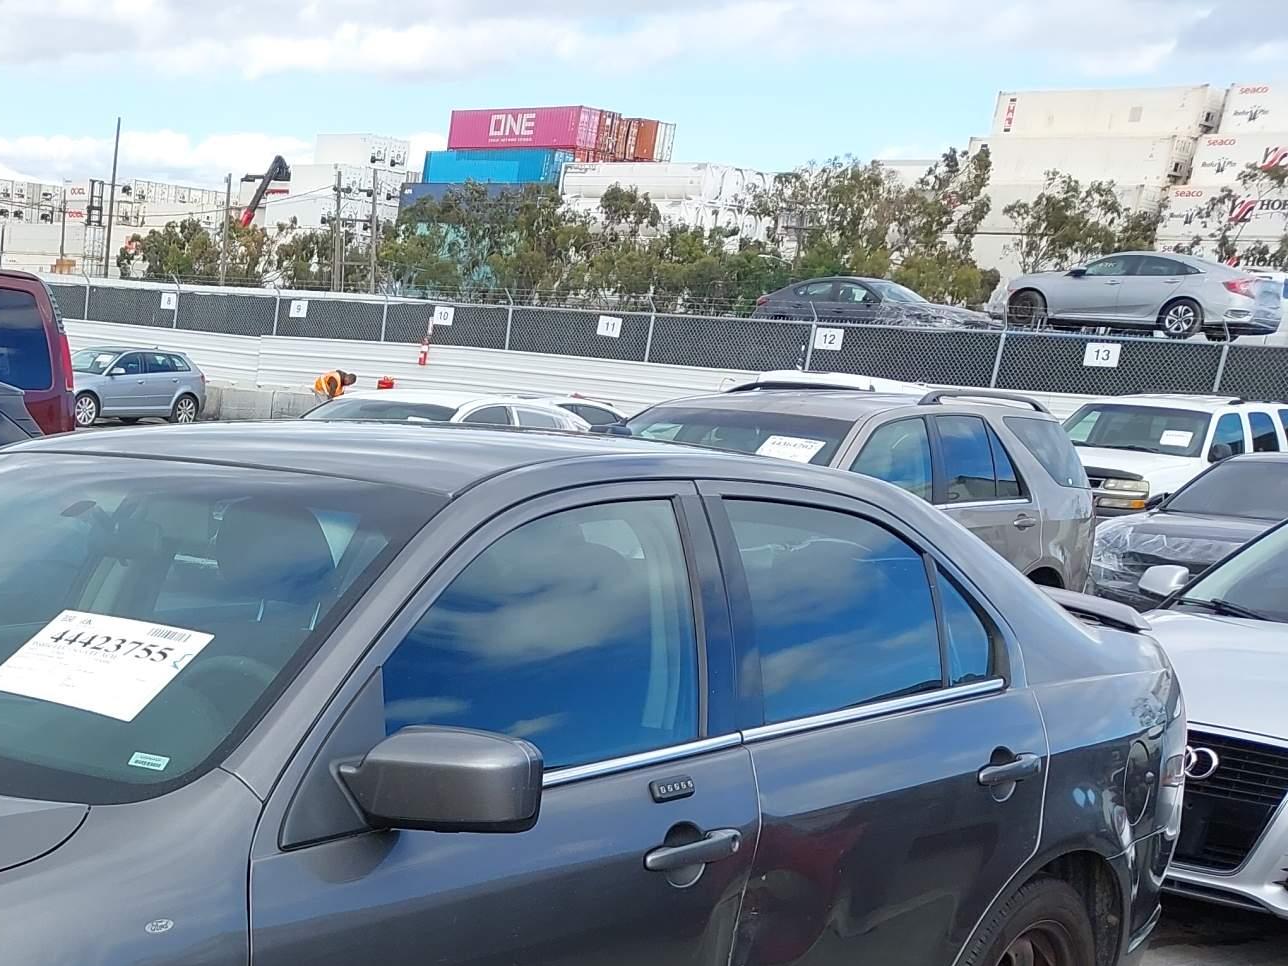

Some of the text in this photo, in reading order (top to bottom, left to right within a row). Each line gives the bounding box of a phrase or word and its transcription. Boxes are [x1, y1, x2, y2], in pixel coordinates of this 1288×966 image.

[1239, 86, 1270, 95] seaco
[489, 113, 536, 137] ONE
[1207, 139, 1237, 147] seaco
[1174, 189, 1204, 198] seaco
[438, 311, 449, 321] 10
[604, 322, 617, 332] 11
[823, 333, 836, 345] 12
[1094, 349, 1111, 361] 13
[49, 629, 174, 662] 44423755
